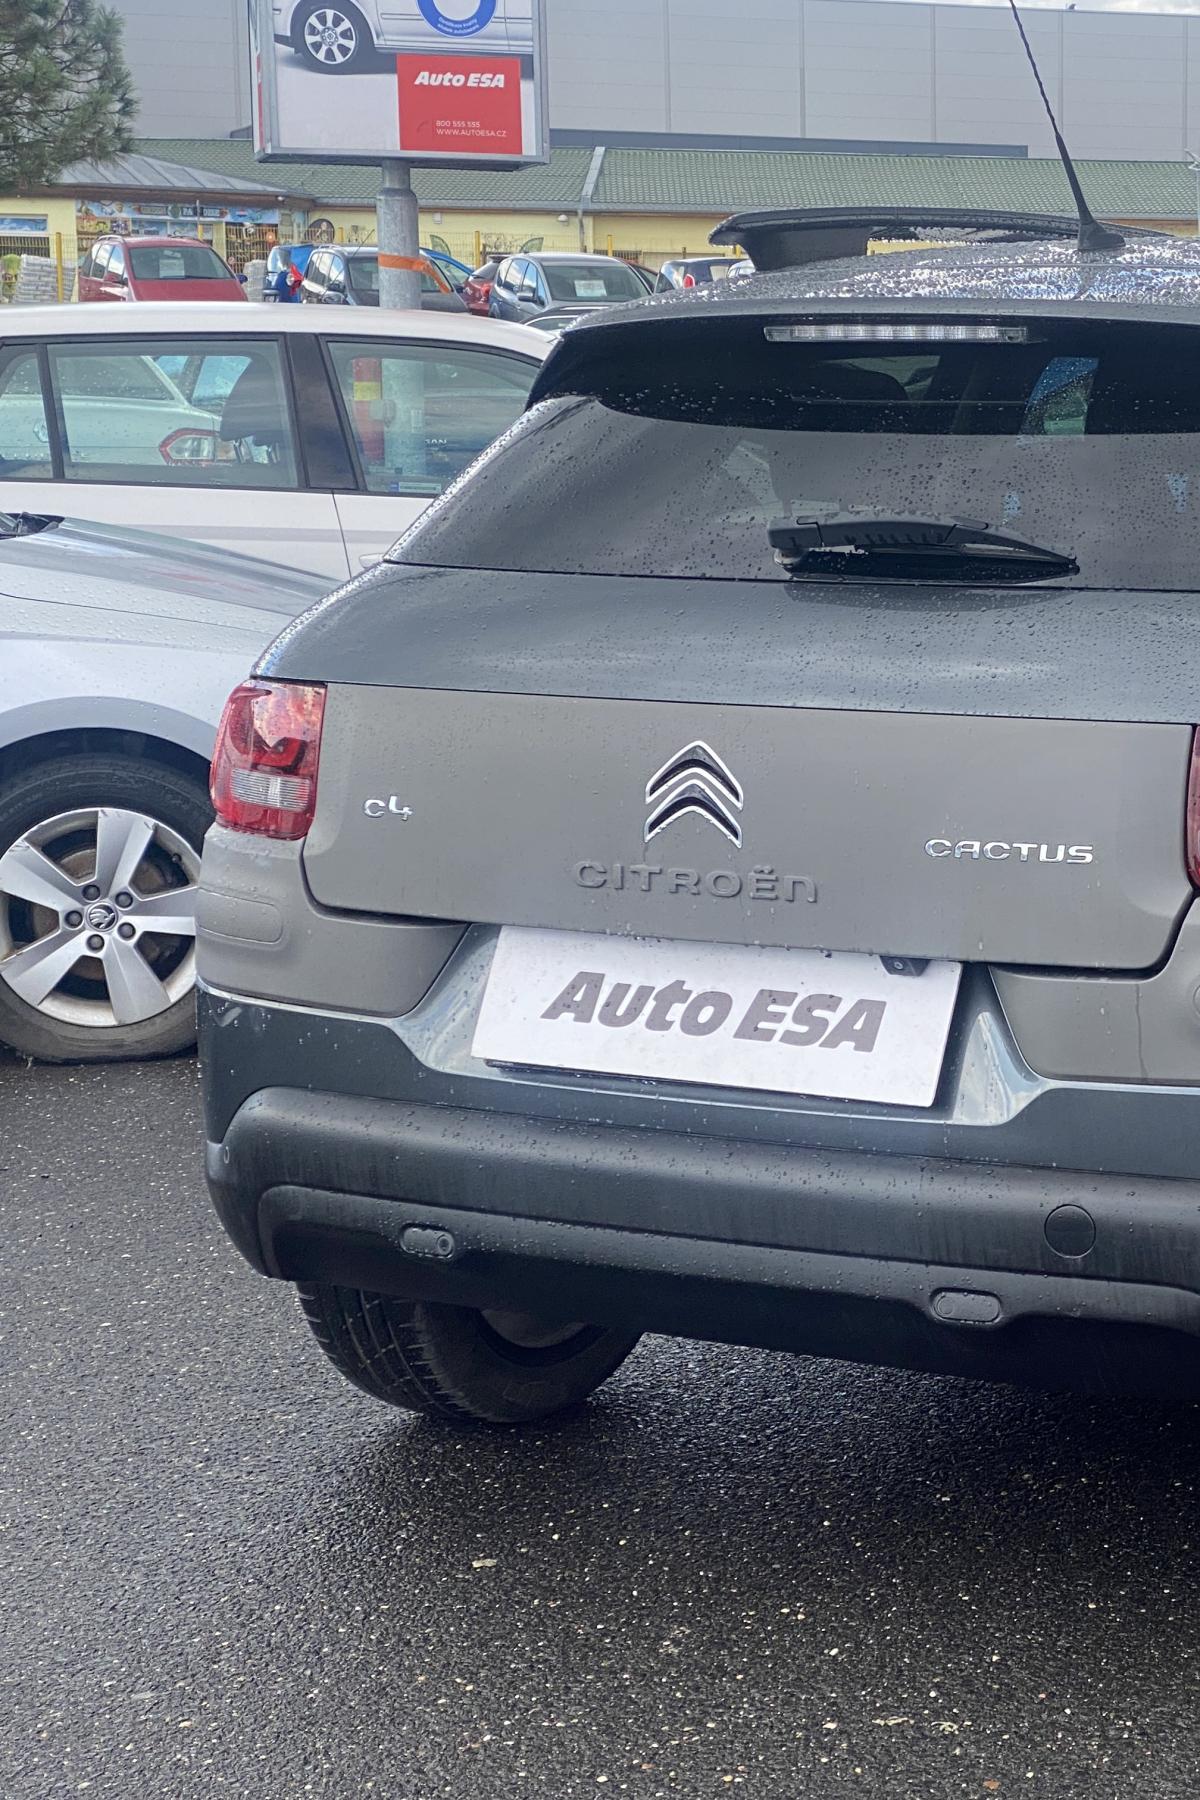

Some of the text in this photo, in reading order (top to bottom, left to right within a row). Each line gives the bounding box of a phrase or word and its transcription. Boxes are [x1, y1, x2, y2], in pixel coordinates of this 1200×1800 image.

[414, 71, 505, 88] Auto ESA
[436, 128, 507, 138] WWW.AUTOESA.CZ
[452, 120, 466, 128] 555
[923, 838, 1094, 866] CACTUS
[573, 859, 819, 904] CITROËN
[541, 971, 888, 1054] Auto ESA
